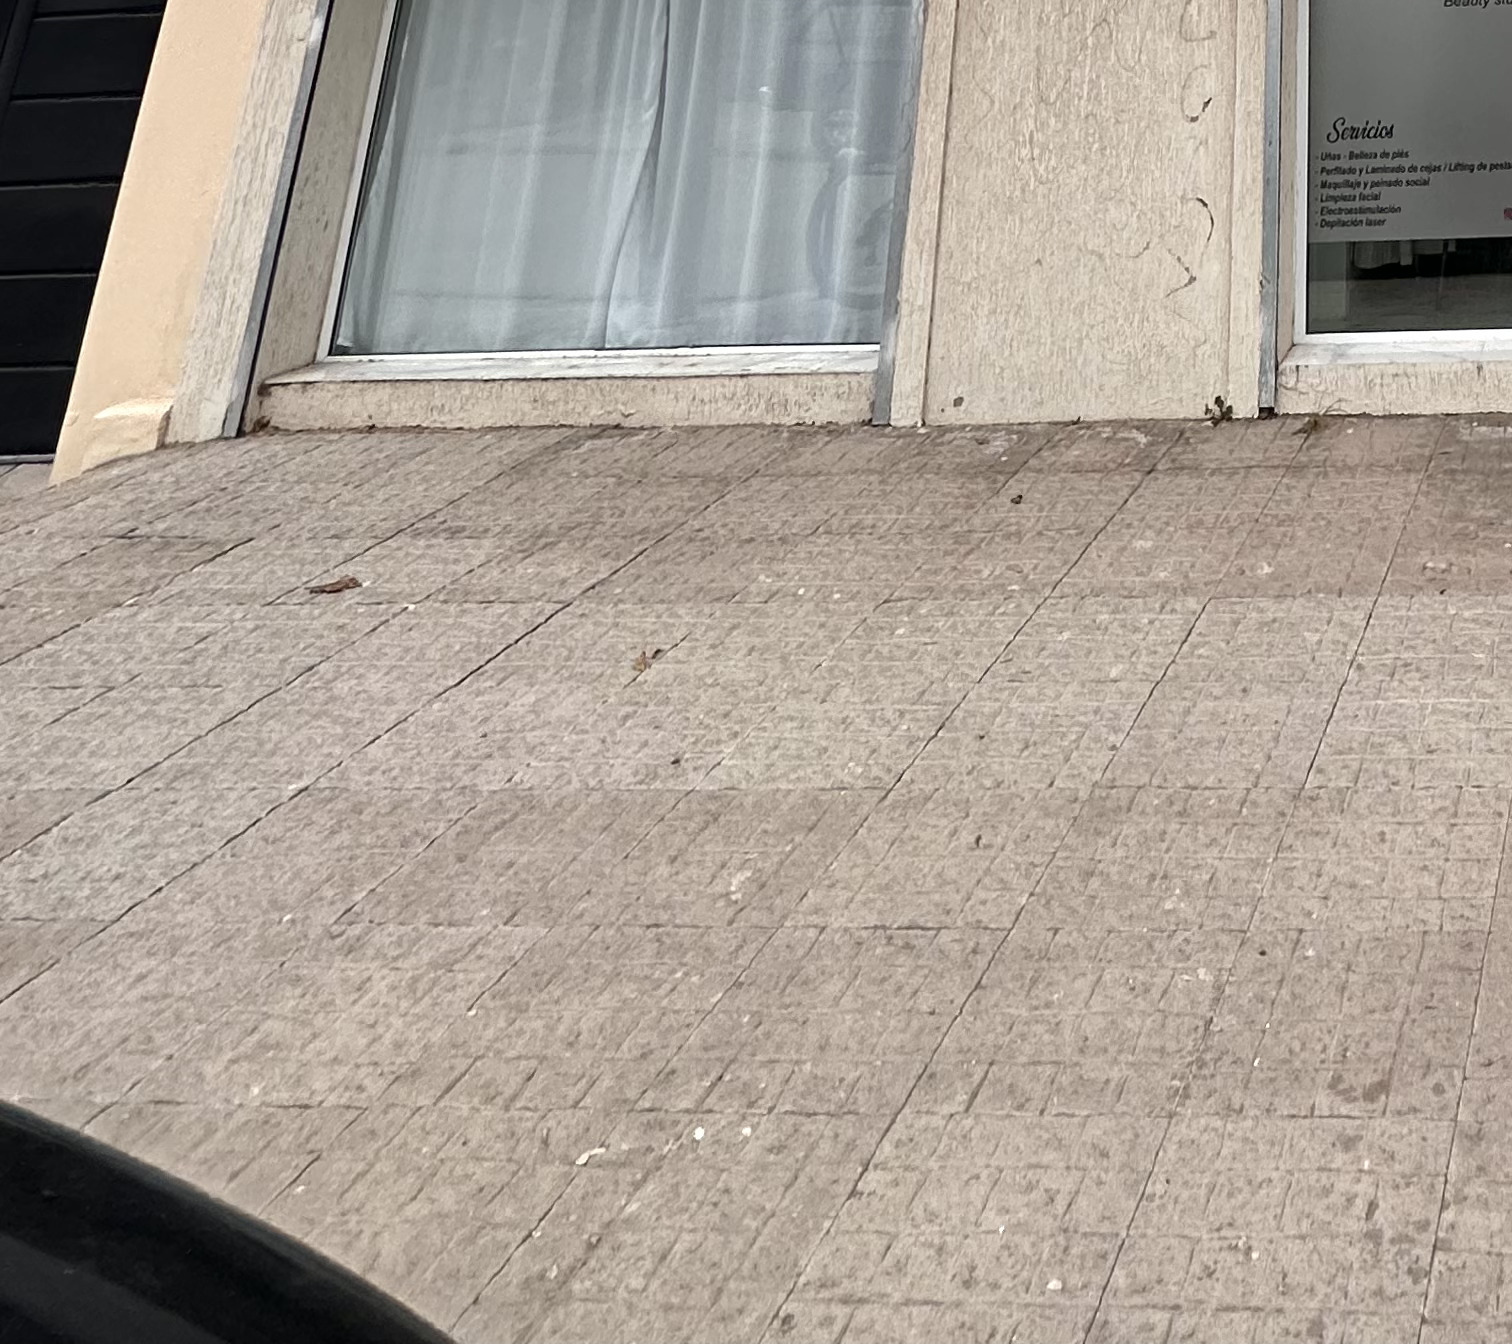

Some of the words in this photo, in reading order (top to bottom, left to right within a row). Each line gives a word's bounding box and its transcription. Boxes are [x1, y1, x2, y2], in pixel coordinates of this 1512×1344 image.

[1326, 117, 1394, 143] Servicios
[1380, 150, 1391, 159] de
[1407, 164, 1418, 173] de
[1476, 161, 1487, 171] de
[1320, 193, 1357, 204] Limpieza
[1358, 191, 1381, 201] facial
